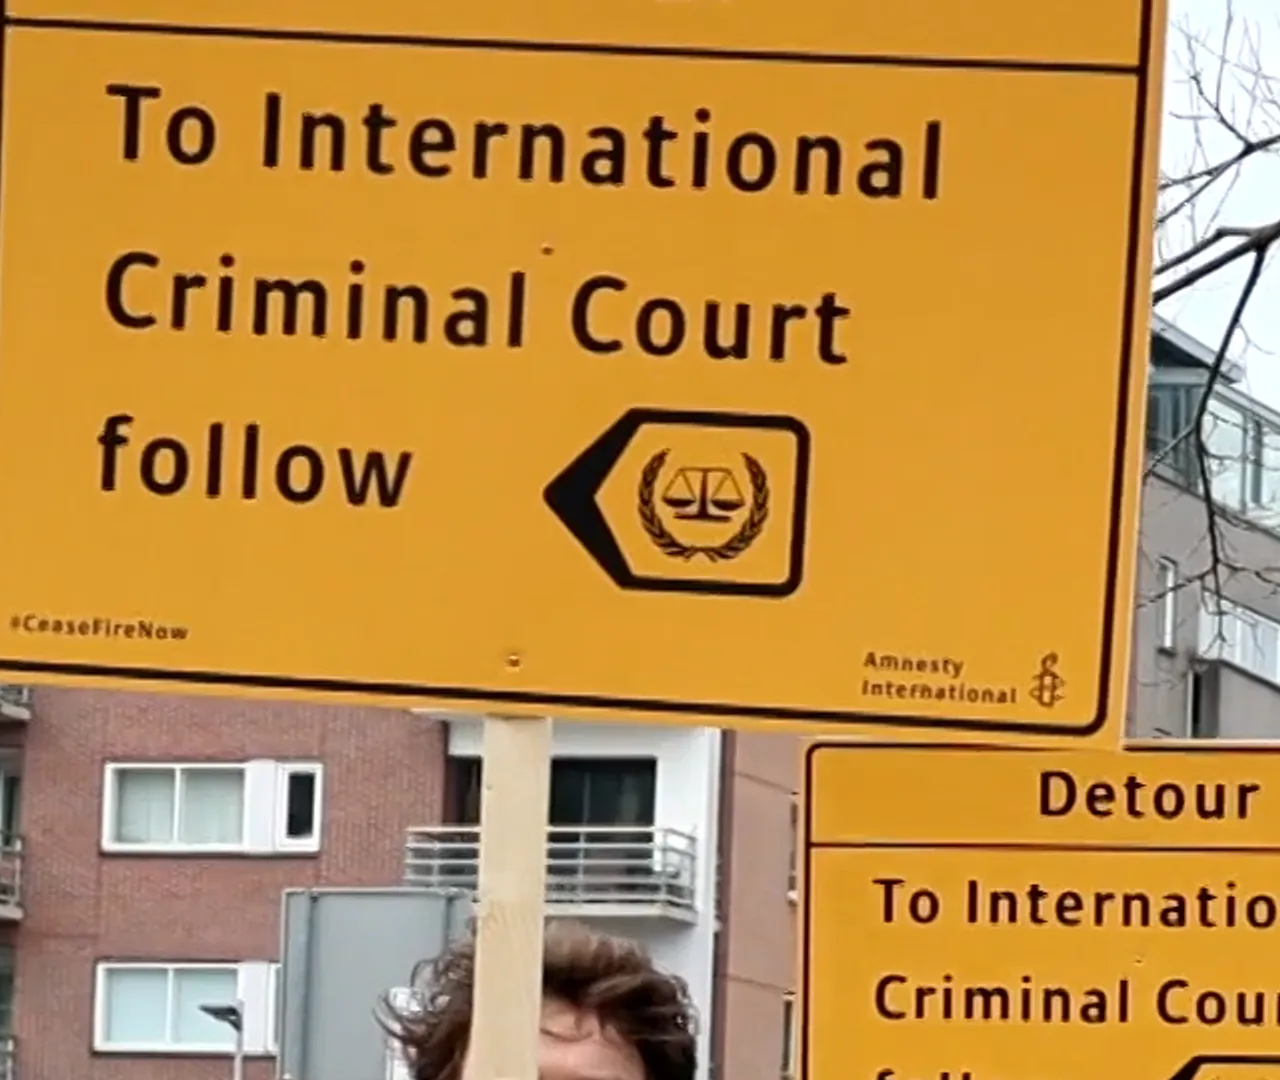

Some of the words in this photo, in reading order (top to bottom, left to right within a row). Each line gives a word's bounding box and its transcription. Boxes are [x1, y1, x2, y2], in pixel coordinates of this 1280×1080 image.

[105, 83, 217, 166] To
[263, 91, 942, 201] International
[104, 251, 527, 349] Criminal
[571, 275, 852, 366] Court
[97, 413, 413, 509] follow
[10, 614, 190, 641] #CeaseFireNow
[863, 651, 965, 680] Amnesty
[860, 679, 1018, 705] International
[1039, 770, 1261, 820] Detour
[872, 878, 941, 926] To
[874, 974, 1130, 1024] Criminal
